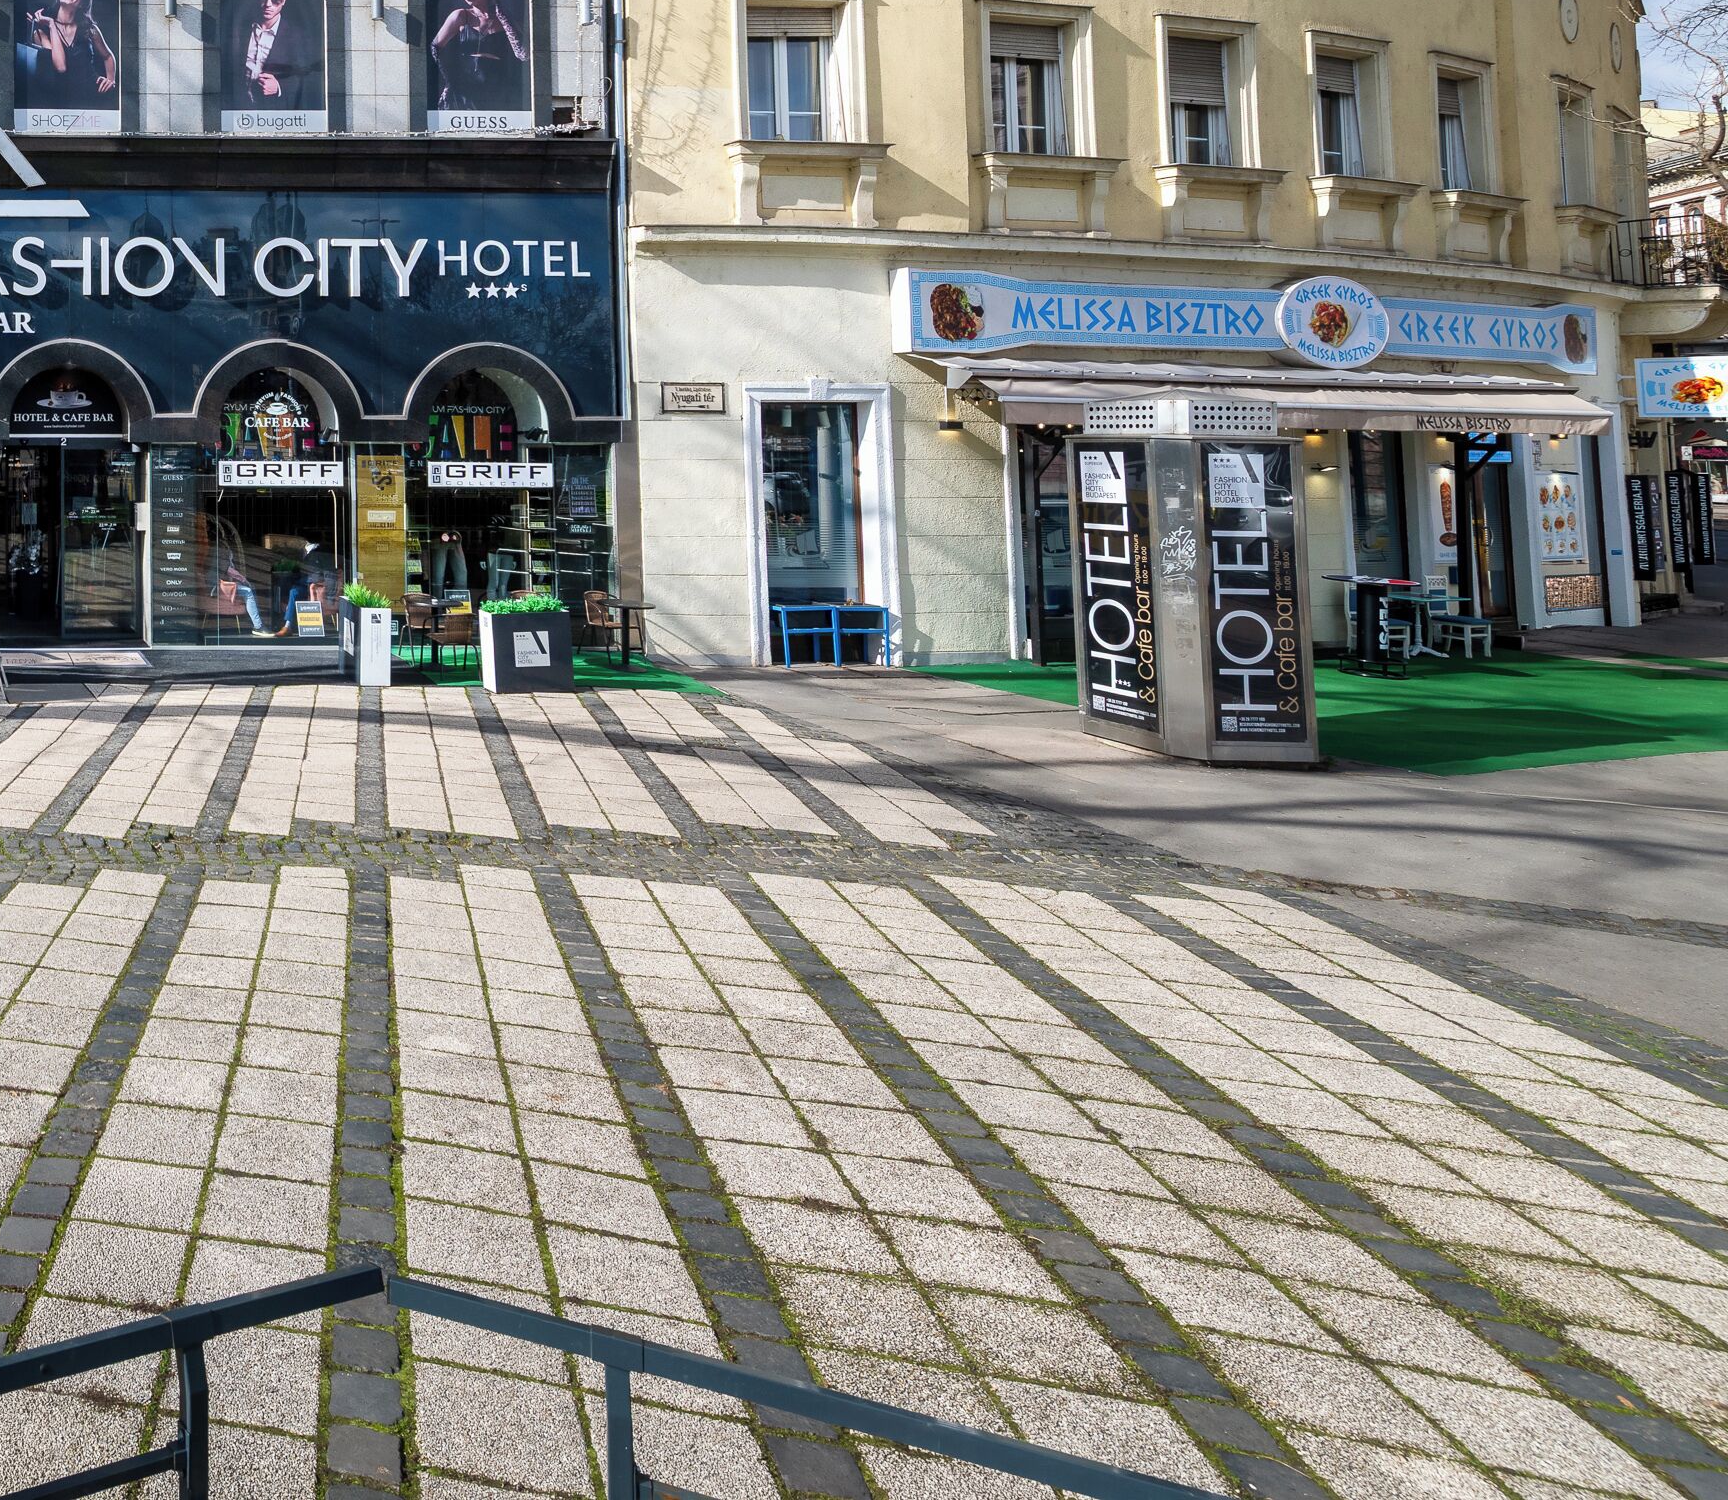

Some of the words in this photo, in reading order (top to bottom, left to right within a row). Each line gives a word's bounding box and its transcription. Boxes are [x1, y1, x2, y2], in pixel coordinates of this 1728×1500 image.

[257, 114, 306, 131] bugatti
[451, 116, 508, 129] GUESS
[254, 236, 428, 298] CITY
[439, 239, 591, 278] HOTEL
[1296, 284, 1331, 304] GREEK
[1335, 285, 1374, 309] GYROS
[1012, 296, 1136, 333] MELISSA
[1146, 300, 1265, 336] BISZTRO
[1398, 311, 1476, 345] GREEK
[1489, 317, 1558, 350] GYROS
[1298, 338, 1337, 362] MELISSA
[1338, 342, 1376, 362] BISZTRO
[671, 392, 701, 404] Nyugati
[703, 392, 715, 402] tér
[1656, 399, 1709, 412] MELISSA
[14, 413, 49, 422] HOTEL
[50, 413, 60, 422] &
[63, 413, 92, 422] CAFE
[94, 413, 115, 422] BAR
[447, 405, 483, 414] FASHION
[486, 406, 506, 414] CITY
[245, 417, 279, 428] CAFE
[283, 417, 311, 428] BAR
[1416, 415, 1463, 430] MELISSA
[1465, 416, 1511, 430] BISZTRO
[61, 437, 67, 446] 2
[237, 463, 338, 477] GRIFF
[446, 464, 547, 479] GRIFF
[1084, 472, 1112, 480] FASHION
[1214, 496, 1254, 504] BUDAPEST
[1669, 476, 1685, 564] WWW.DARTSGALERIA.HU
[1084, 506, 1138, 699] HOTEL
[1135, 586, 1152, 624] bar
[1212, 511, 1278, 711] HOTEL
[1274, 594, 1293, 631] bar
[1136, 629, 1154, 681] Cafe
[1274, 637, 1297, 690] Cafe
[1139, 687, 1156, 703] &
[1279, 696, 1299, 713] &
